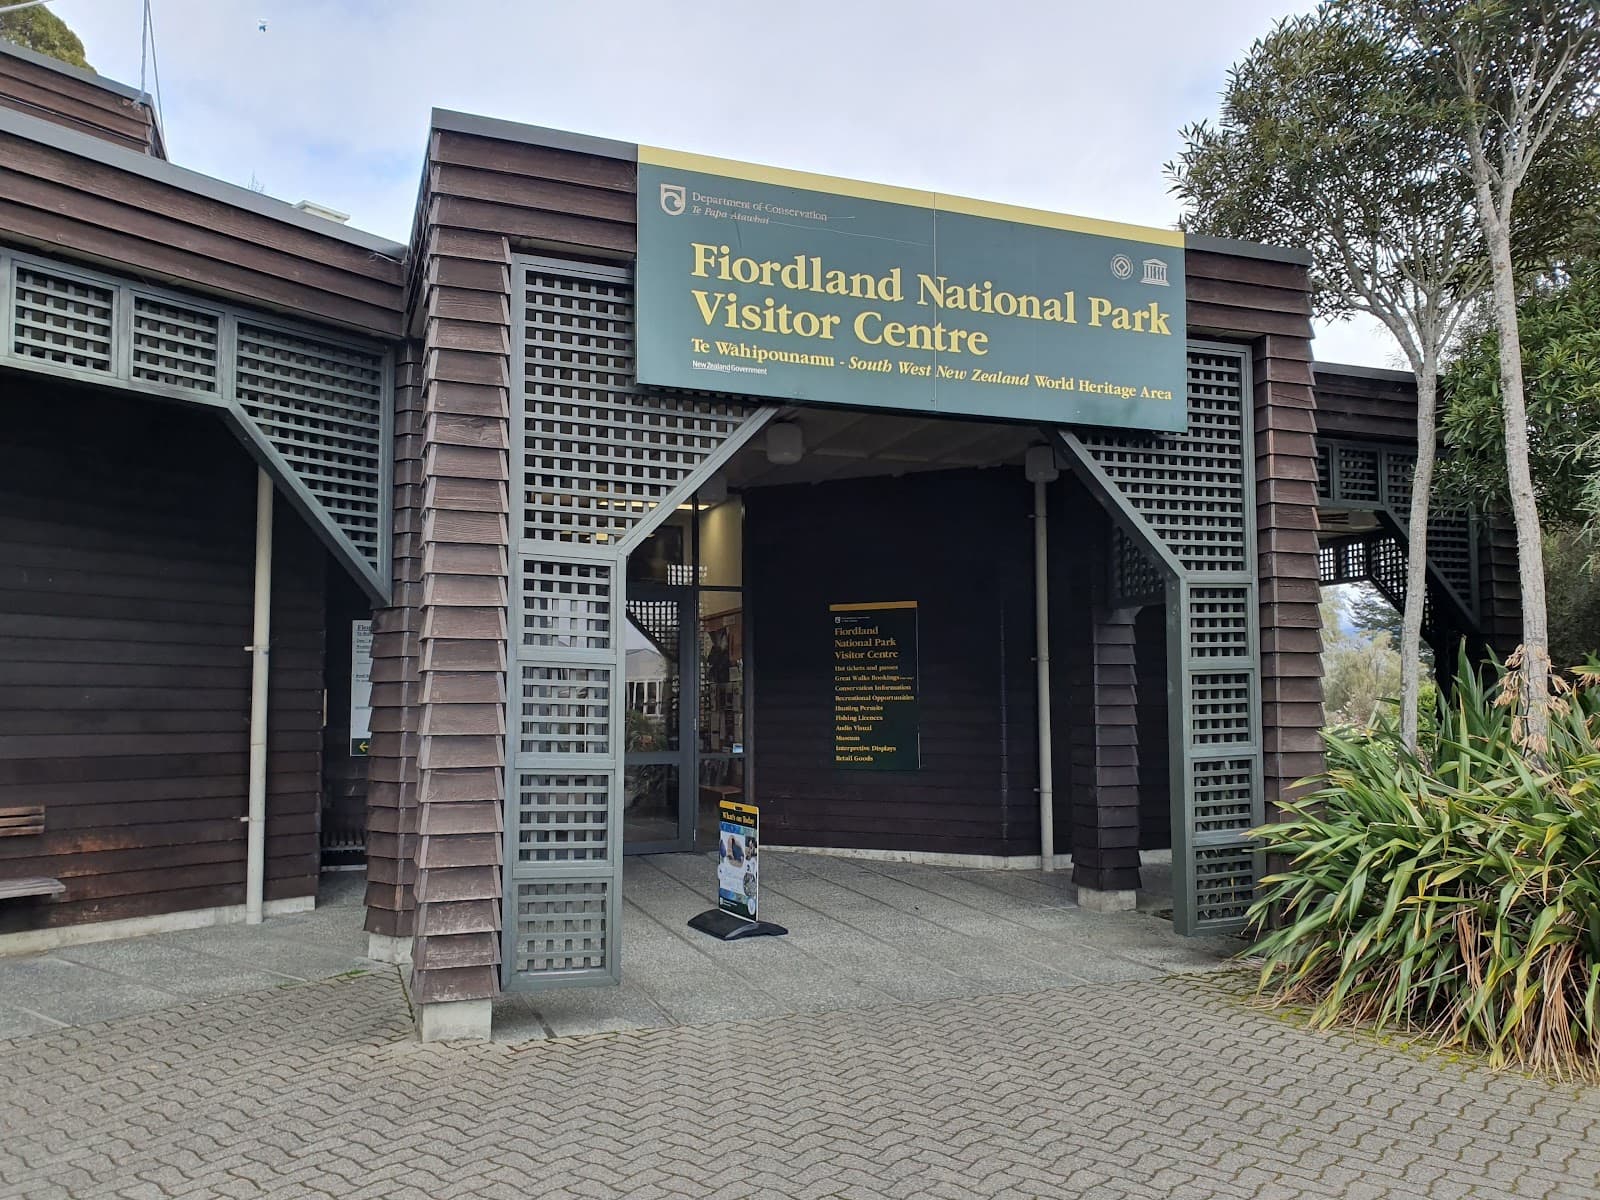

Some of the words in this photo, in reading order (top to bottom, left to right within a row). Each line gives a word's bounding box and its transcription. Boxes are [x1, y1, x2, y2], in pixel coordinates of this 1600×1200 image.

[692, 191, 751, 210] Department
[753, 202, 763, 211] of
[765, 203, 828, 221] Conservation
[692, 205, 702, 214] Te
[704, 207, 728, 219] Papa
[730, 212, 769, 225] Atawhai
[691, 242, 904, 302] Fiordland
[917, 273, 1077, 324] National
[1088, 296, 1172, 336] Park
[691, 289, 841, 340] Visitor
[853, 311, 989, 356] Centre
[691, 338, 710, 353] Te
[848, 356, 892, 373] South
[899, 361, 932, 377] West
[935, 364, 967, 380] New
[971, 369, 1030, 387] Zealand
[1034, 374, 1074, 391] World
[1078, 379, 1137, 400] Heritage
[1140, 385, 1172, 401] Area
[692, 360, 707, 369] New
[731, 364, 767, 376] Government
[835, 626, 879, 636] Fiordland
[834, 638, 872, 648] National
[874, 637, 897, 647] Park
[834, 650, 865, 660] Visitor
[867, 649, 899, 659] Centre
[835, 674, 851, 682] Great
[852, 674, 870, 682] Walks
[835, 694, 871, 702] Recreational
[853, 724, 872, 732] Visual
[871, 745, 896, 753] Displays
[736, 815, 742, 823] on
[742, 815, 755, 827] Today
